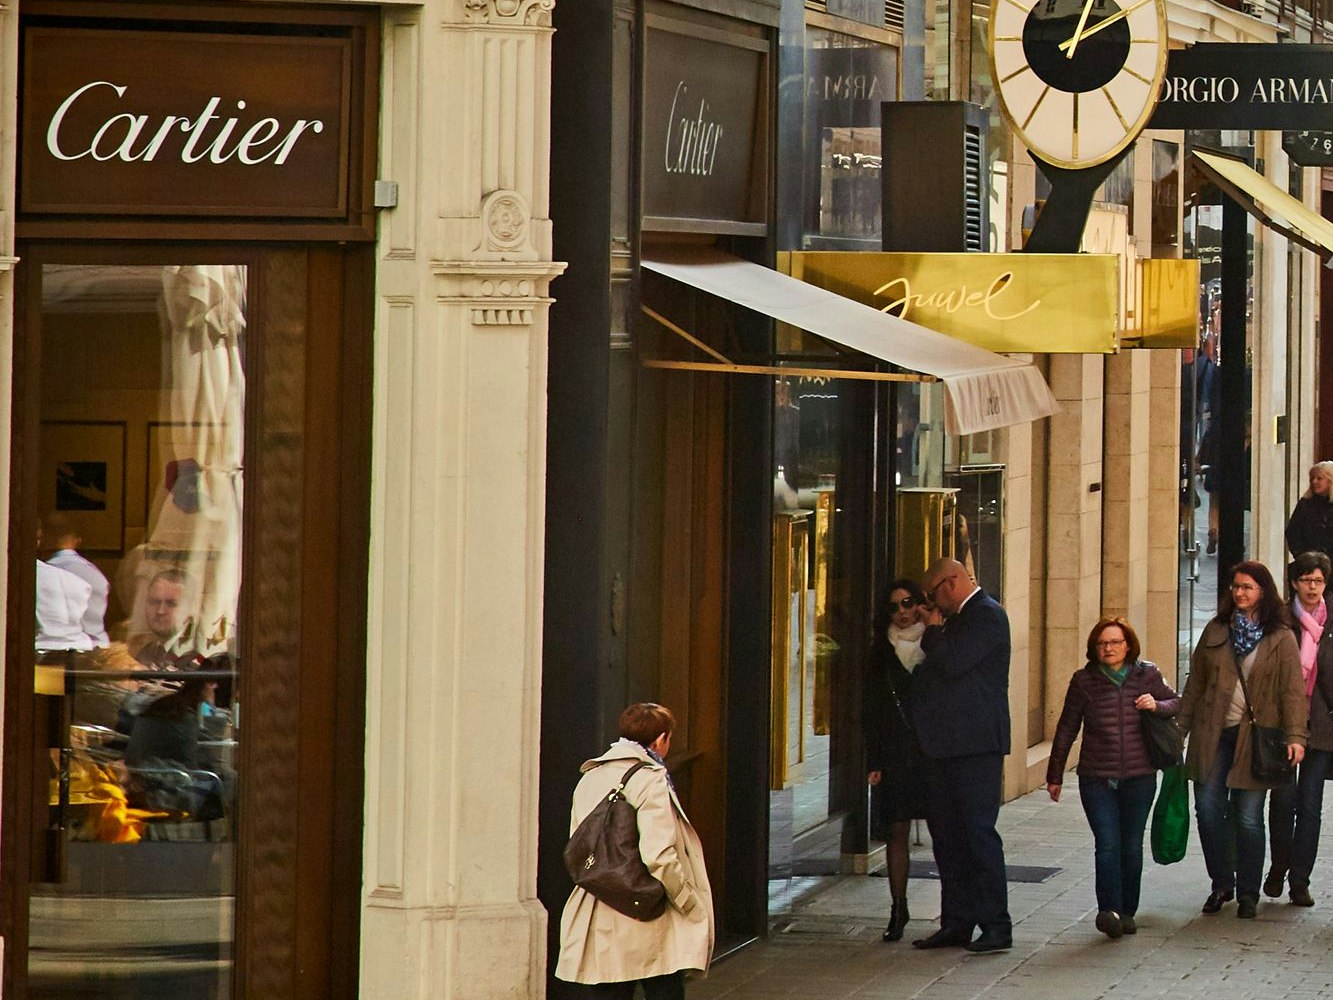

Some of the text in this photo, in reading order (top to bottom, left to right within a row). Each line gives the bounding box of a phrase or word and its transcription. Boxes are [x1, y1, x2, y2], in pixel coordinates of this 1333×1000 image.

[47, 81, 323, 166] Cartier
[663, 80, 724, 177] Cartier
[873, 270, 1041, 320] Juwel
